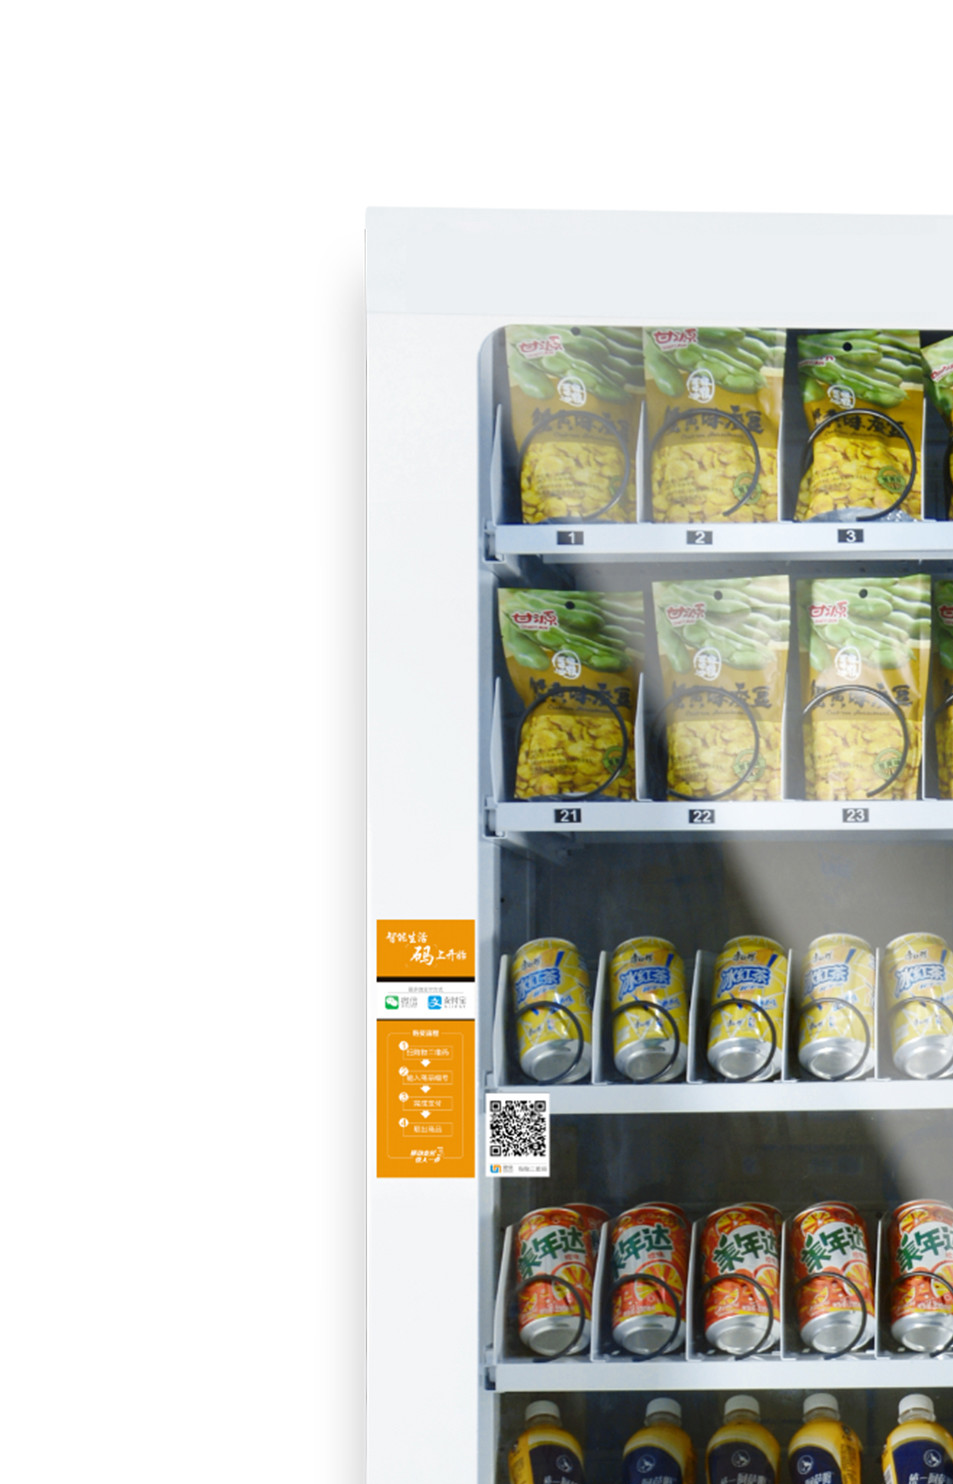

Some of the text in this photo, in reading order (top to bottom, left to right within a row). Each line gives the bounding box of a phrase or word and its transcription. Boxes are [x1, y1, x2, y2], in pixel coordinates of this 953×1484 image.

[560, 810, 578, 821] 21
[692, 810, 711, 822] 22
[846, 809, 865, 822] 23
[386, 931, 428, 944] 智能生活
[410, 945, 467, 966] 码上开始
[618, 967, 671, 1001] 冰红茶
[718, 965, 771, 998] 冰红茶
[895, 963, 946, 998] 冰红茶
[519, 1226, 586, 1278] 美年达
[713, 1230, 778, 1273] 美年达
[801, 1226, 866, 1273] 美年达
